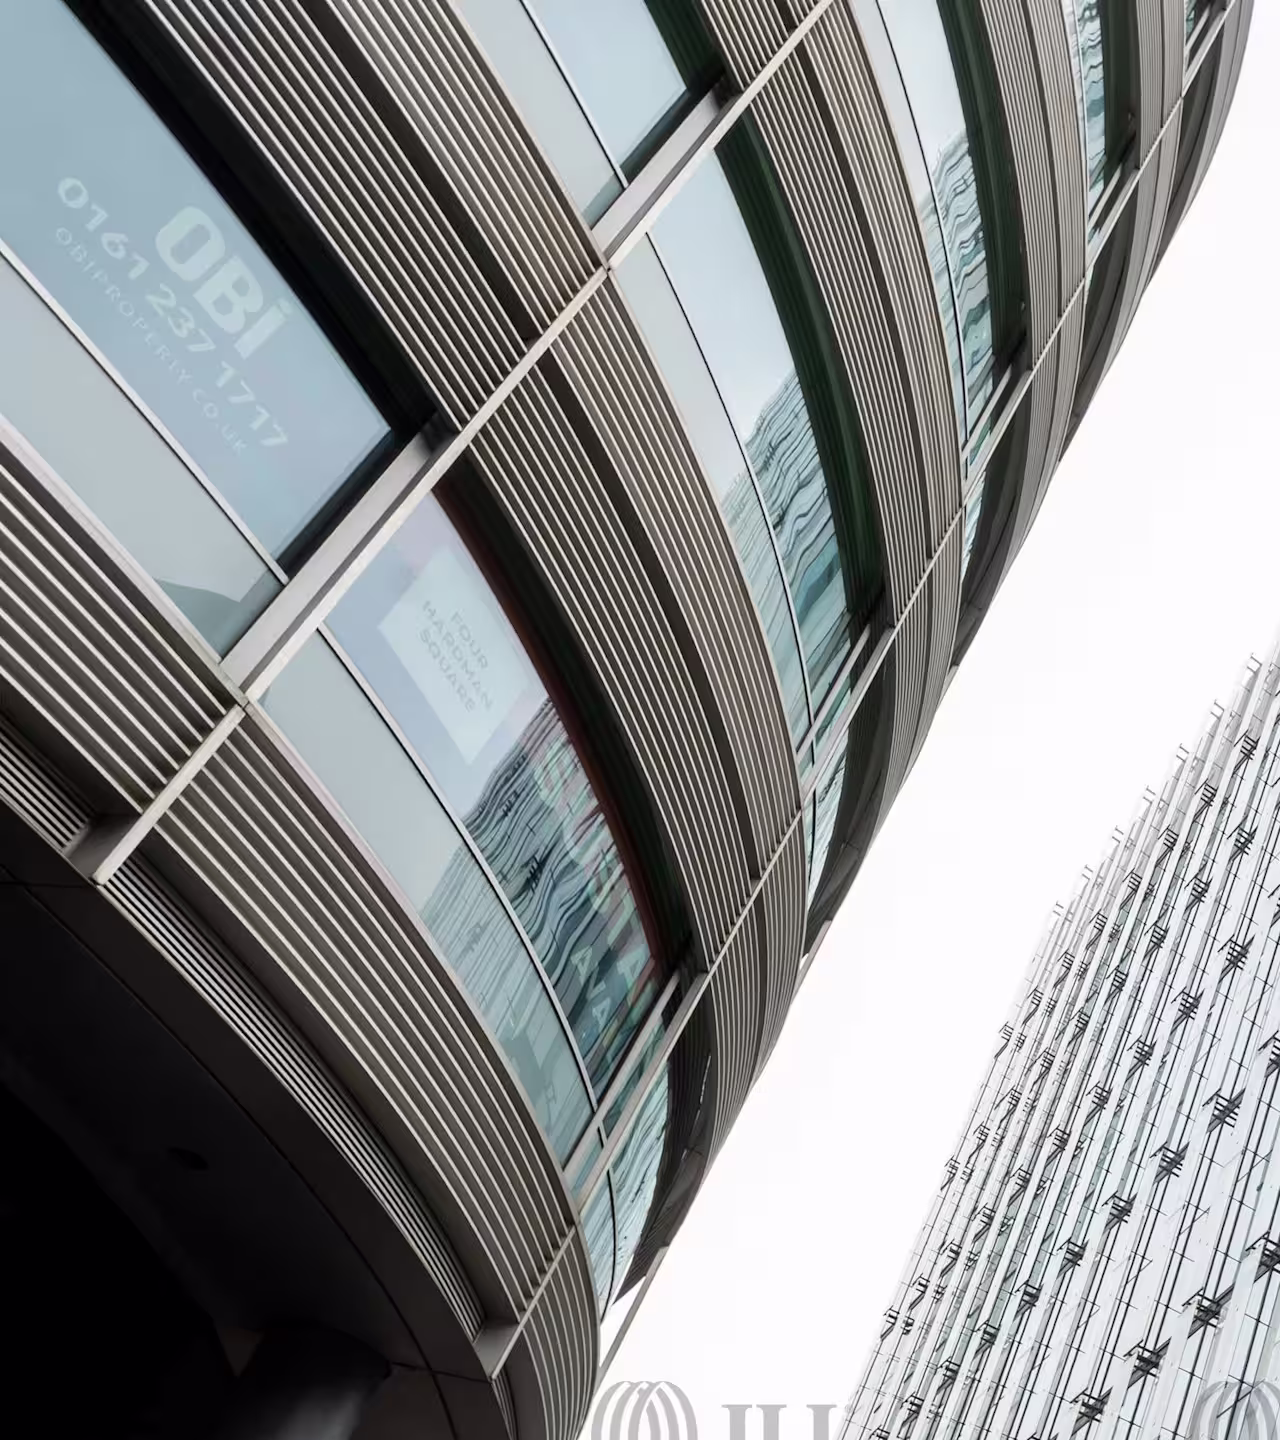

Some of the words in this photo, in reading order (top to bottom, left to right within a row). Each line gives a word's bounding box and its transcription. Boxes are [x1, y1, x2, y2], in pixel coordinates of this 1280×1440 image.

[57, 177, 150, 281] 0161
[145, 283, 216, 352] 237
[216, 361, 288, 447] 1717
[419, 628, 475, 713] SQUARE
[422, 601, 493, 712] HARDMAN
[451, 611, 489, 670] FOUR
